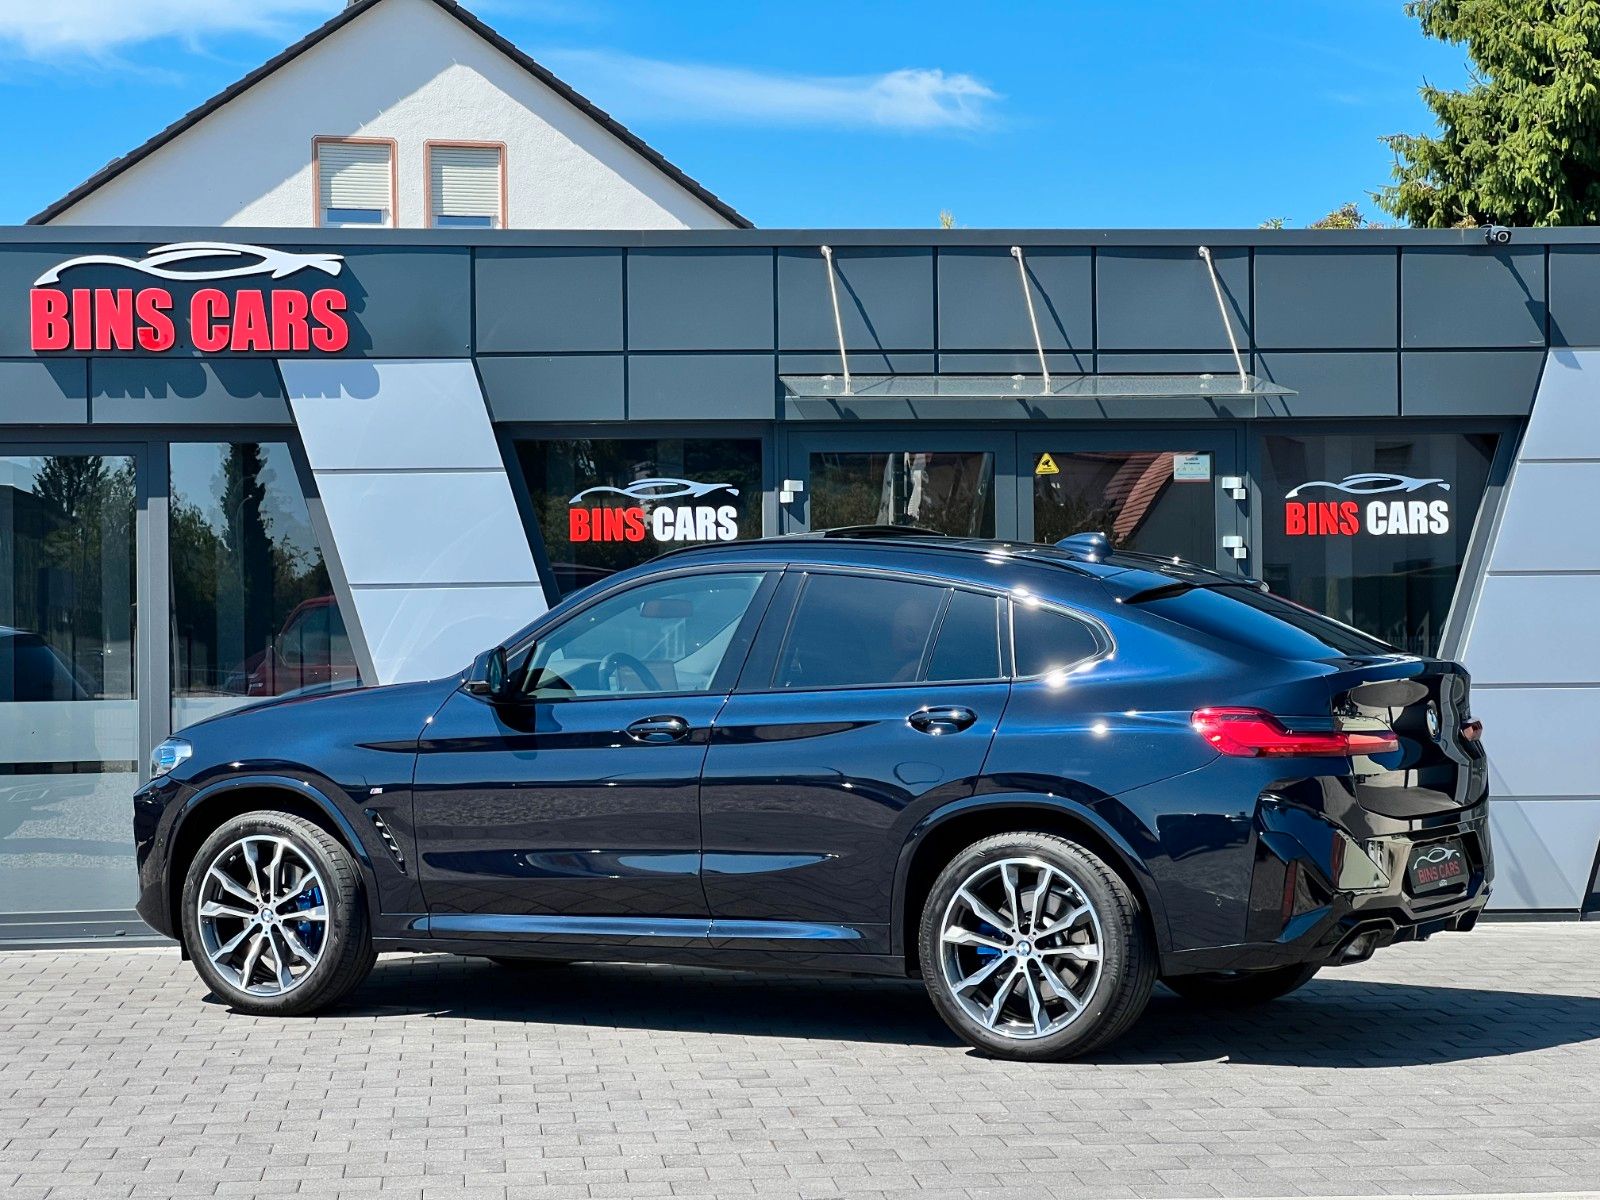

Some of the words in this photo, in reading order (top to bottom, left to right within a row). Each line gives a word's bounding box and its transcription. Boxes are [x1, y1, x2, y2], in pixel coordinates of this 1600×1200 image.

[30, 287, 175, 351] BINS
[190, 288, 348, 352] CARS
[569, 506, 646, 542] BINS
[652, 505, 738, 541] CARS
[1285, 501, 1360, 536] BINS
[1366, 500, 1449, 536] CARS
[1418, 866, 1438, 884] BINS
[1439, 860, 1461, 879] CARS
